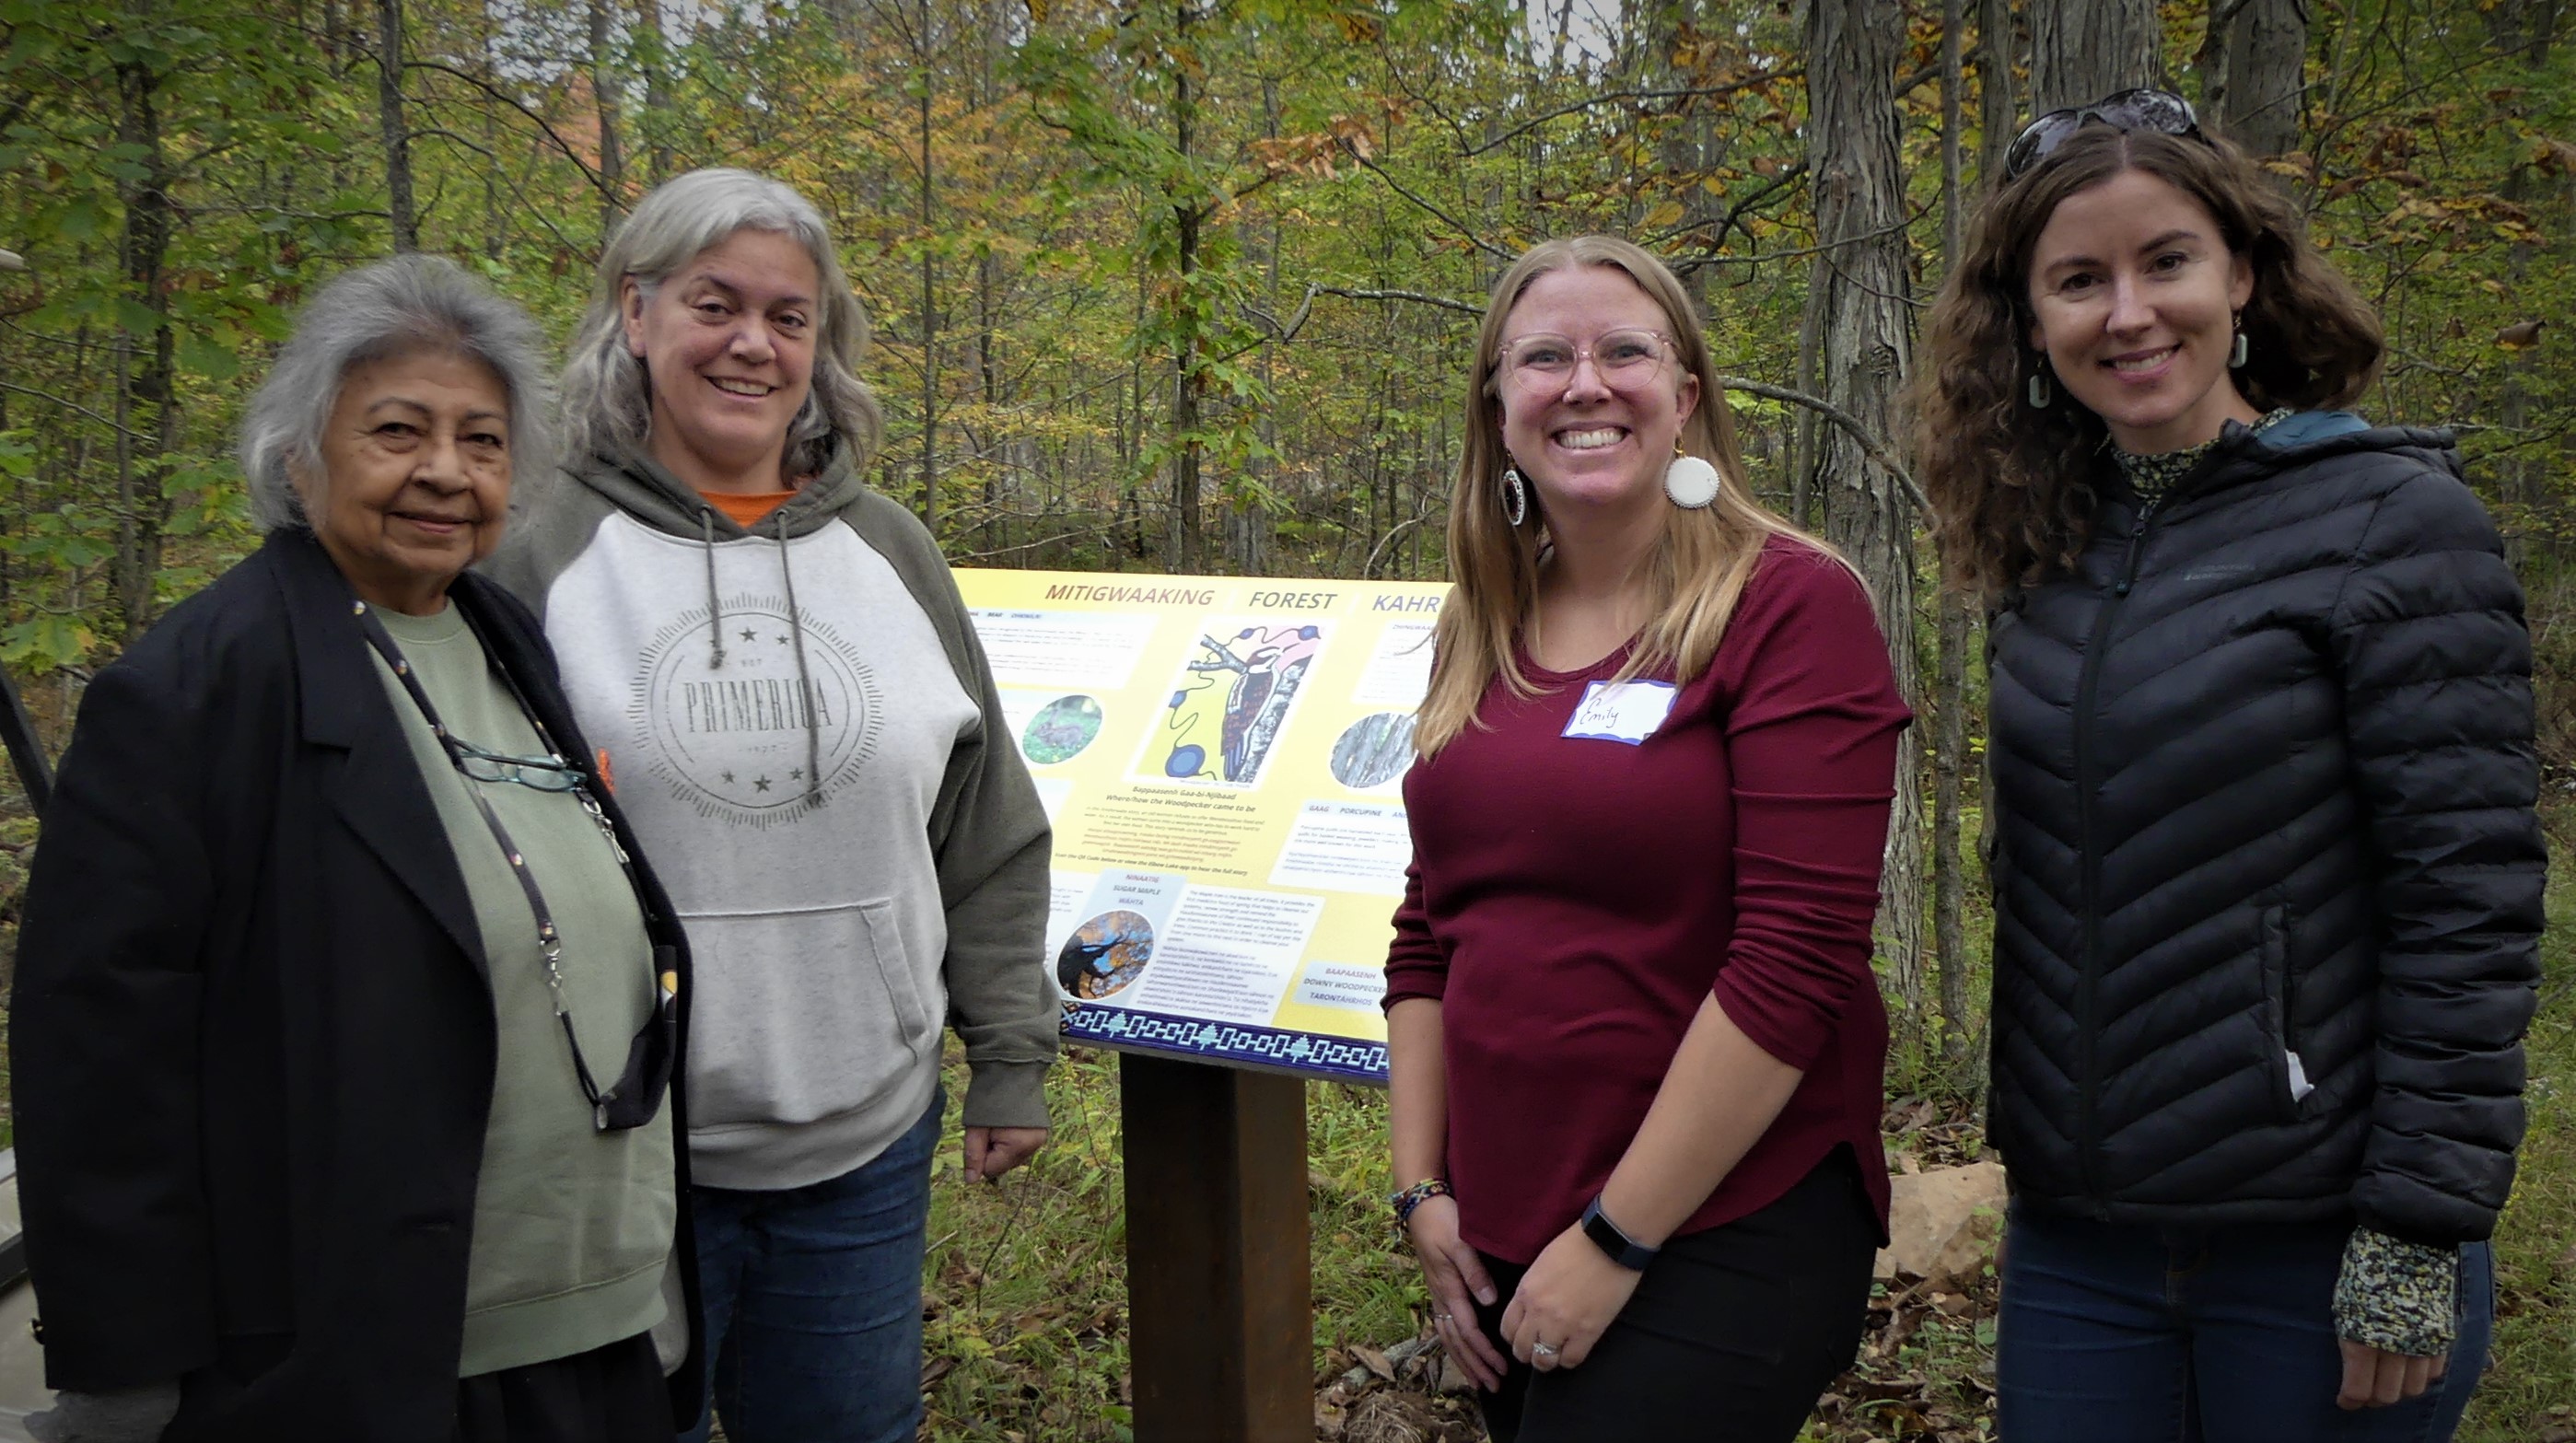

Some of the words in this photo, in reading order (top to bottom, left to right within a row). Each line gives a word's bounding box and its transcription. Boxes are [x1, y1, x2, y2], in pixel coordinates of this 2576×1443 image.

[1044, 585, 1215, 606] MITIGWAAKING
[1249, 591, 1337, 609] FOREST
[1372, 595, 1440, 612] KAHR
[683, 679, 833, 732] PRIMERICA
[1579, 697, 1619, 728] Emily
[1164, 798, 1212, 809] Woodpecker
[1339, 808, 1381, 816] PORCUPINE
[1125, 874, 1160, 883] NINAATIG
[1113, 884, 1136, 893] SUGAR
[1137, 886, 1160, 896] MAPLE
[1325, 968, 1377, 979] BAAPAASENH
[1303, 978, 1334, 986] DOWNY
[1335, 982, 1387, 994] WOODPECKER
